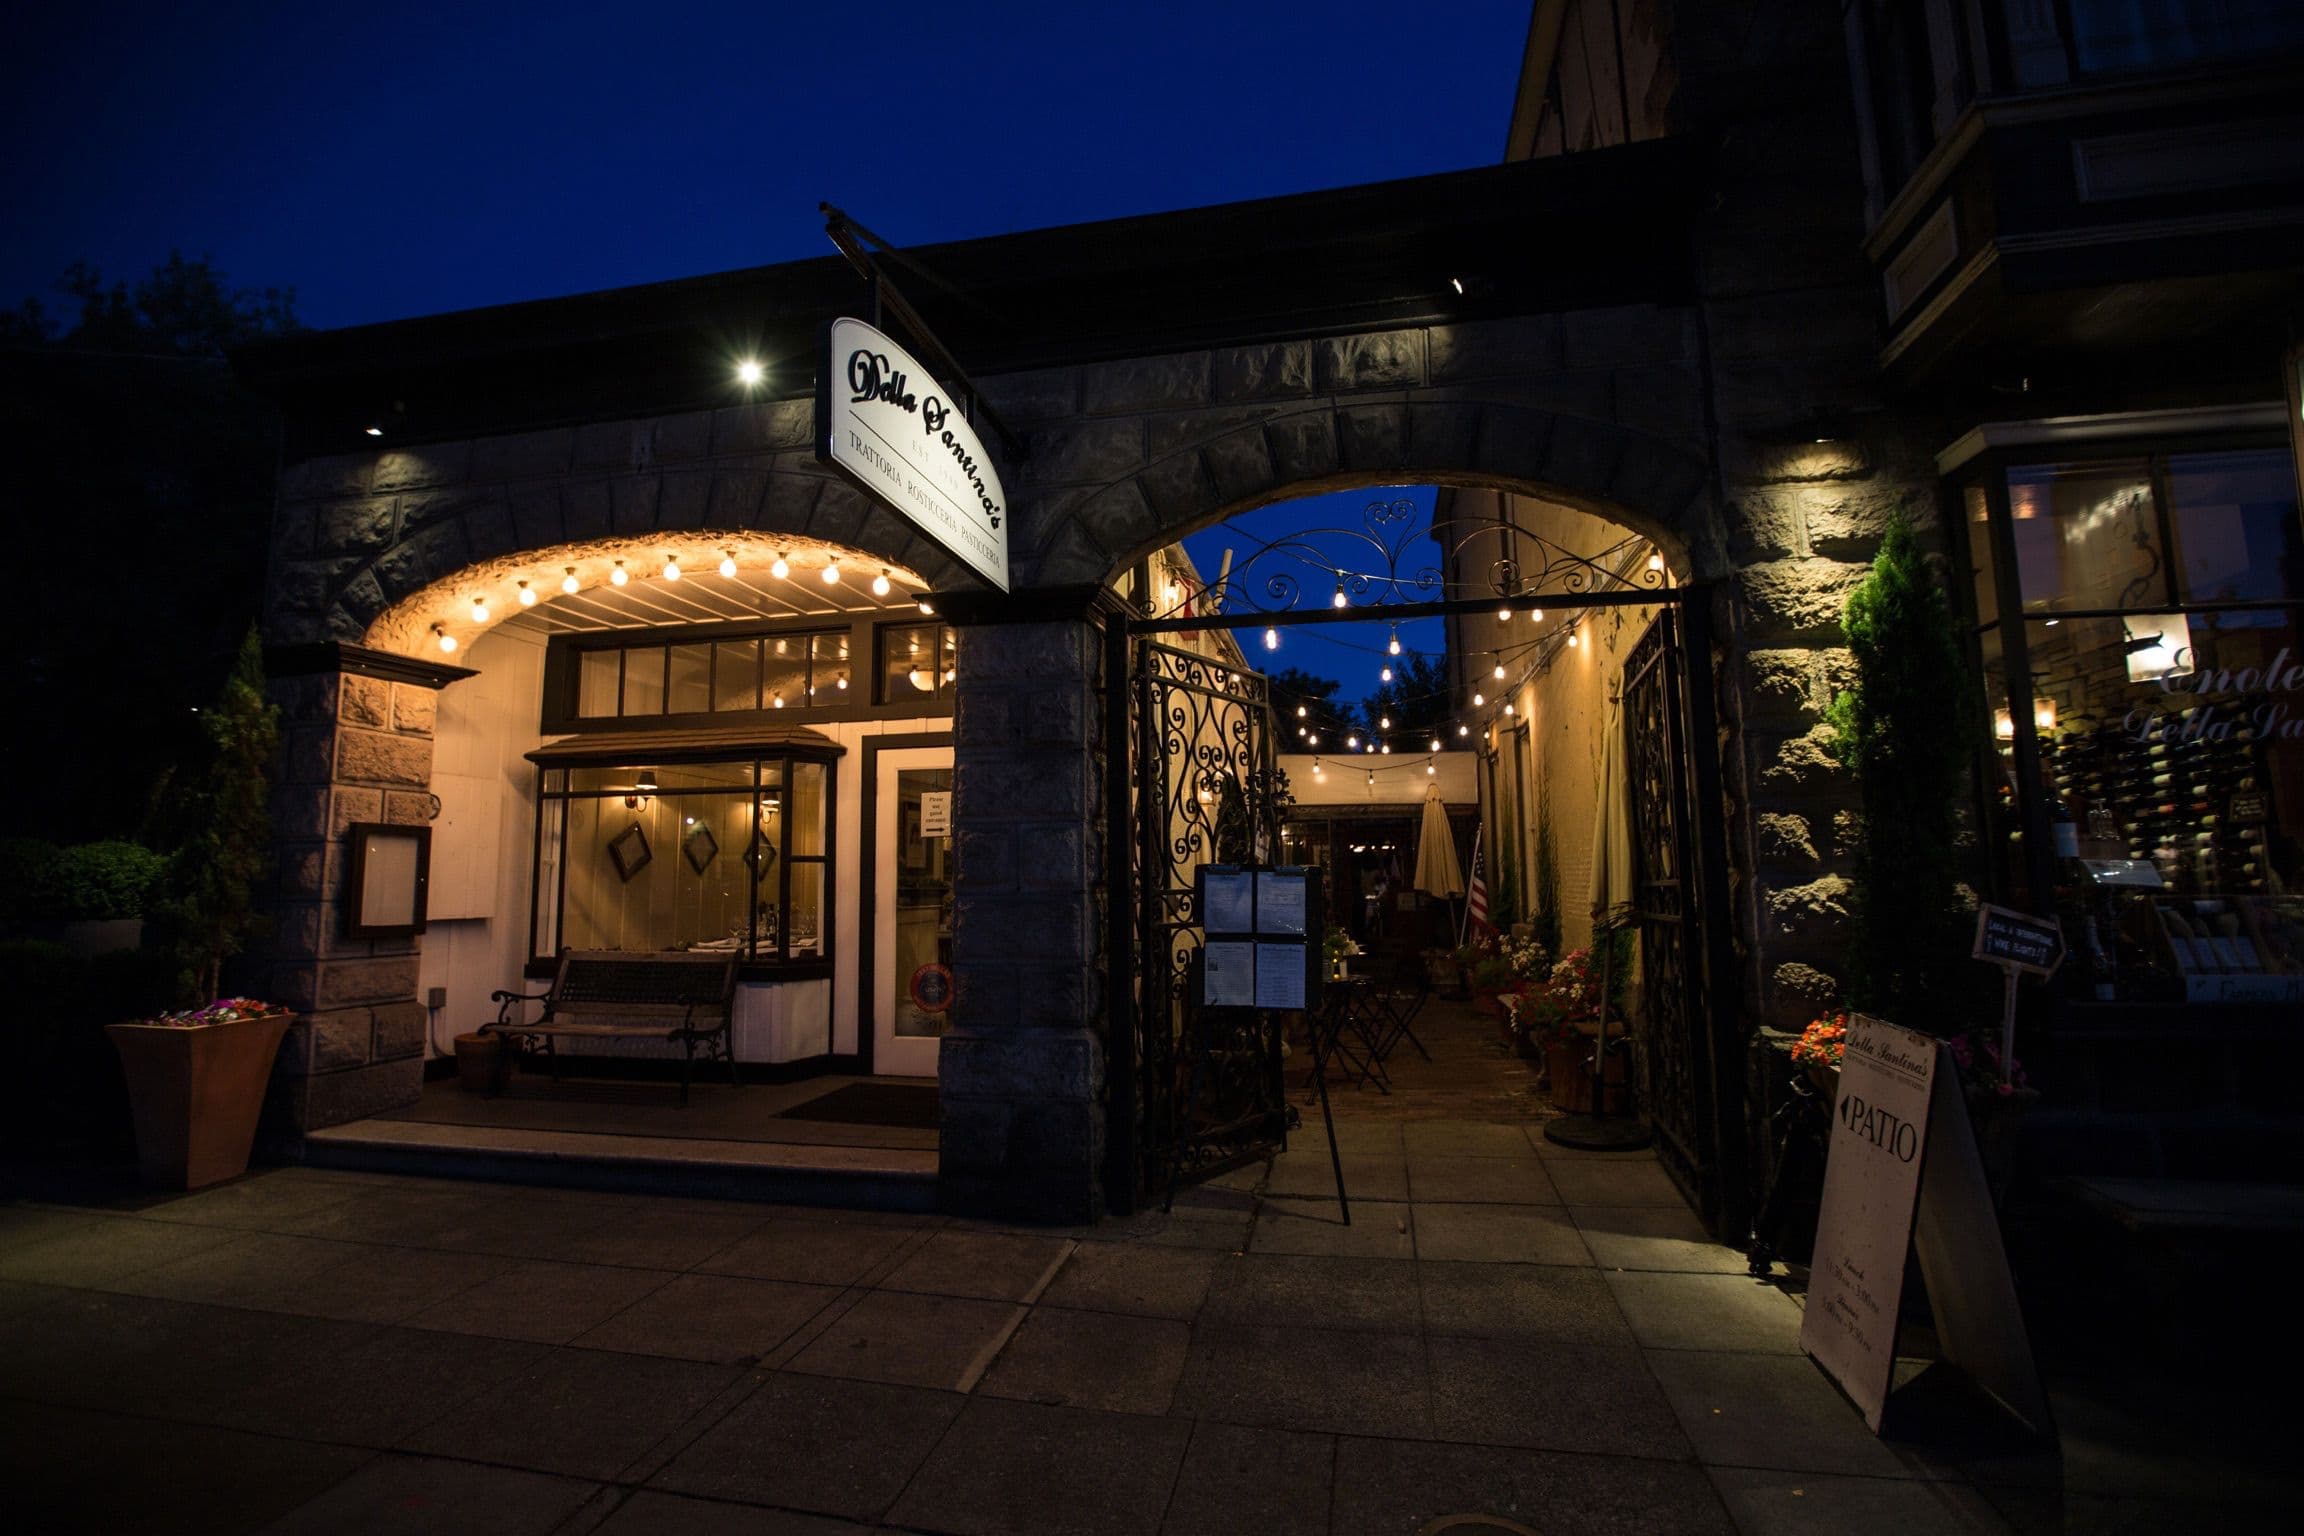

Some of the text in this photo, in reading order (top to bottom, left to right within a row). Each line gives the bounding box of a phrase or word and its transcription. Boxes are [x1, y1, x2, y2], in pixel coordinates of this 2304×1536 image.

[848, 350, 1002, 530] Della Santina's
[849, 430, 902, 488] TRATTORIA
[907, 480, 957, 532] ROSTICCERIA
[961, 526, 1001, 569] PASTICCERIA
[1847, 1031, 1874, 1055] Della
[1877, 1042, 1928, 1077] Santina's
[1848, 1095, 1916, 1163] PATIO
